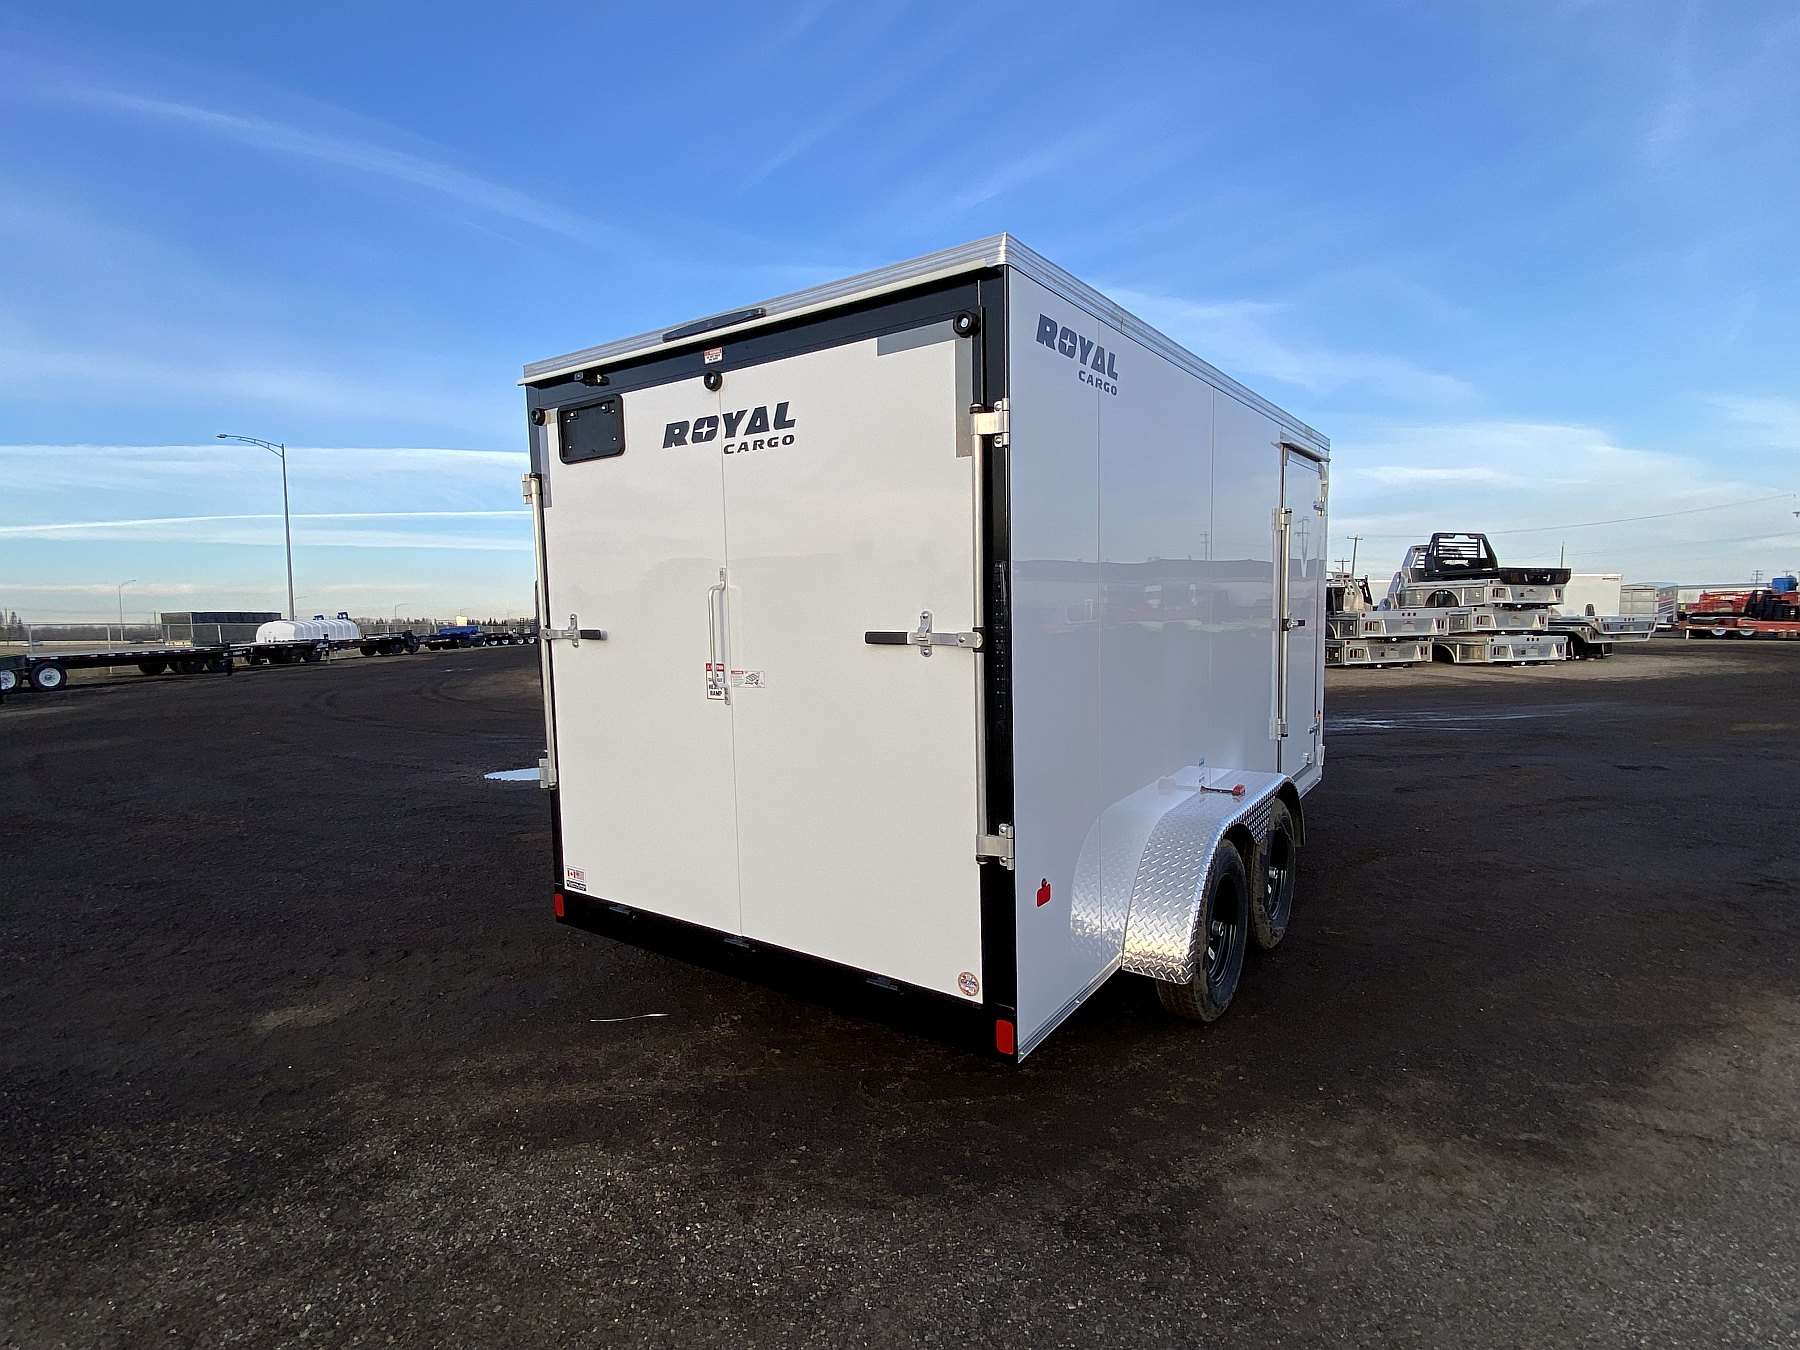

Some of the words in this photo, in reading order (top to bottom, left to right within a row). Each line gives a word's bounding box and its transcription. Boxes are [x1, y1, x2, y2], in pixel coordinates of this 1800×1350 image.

[1036, 313, 1118, 381] ROYAL
[1079, 370, 1118, 396] CARGO
[662, 401, 796, 449] ROYAL
[723, 434, 795, 455] CARGO
